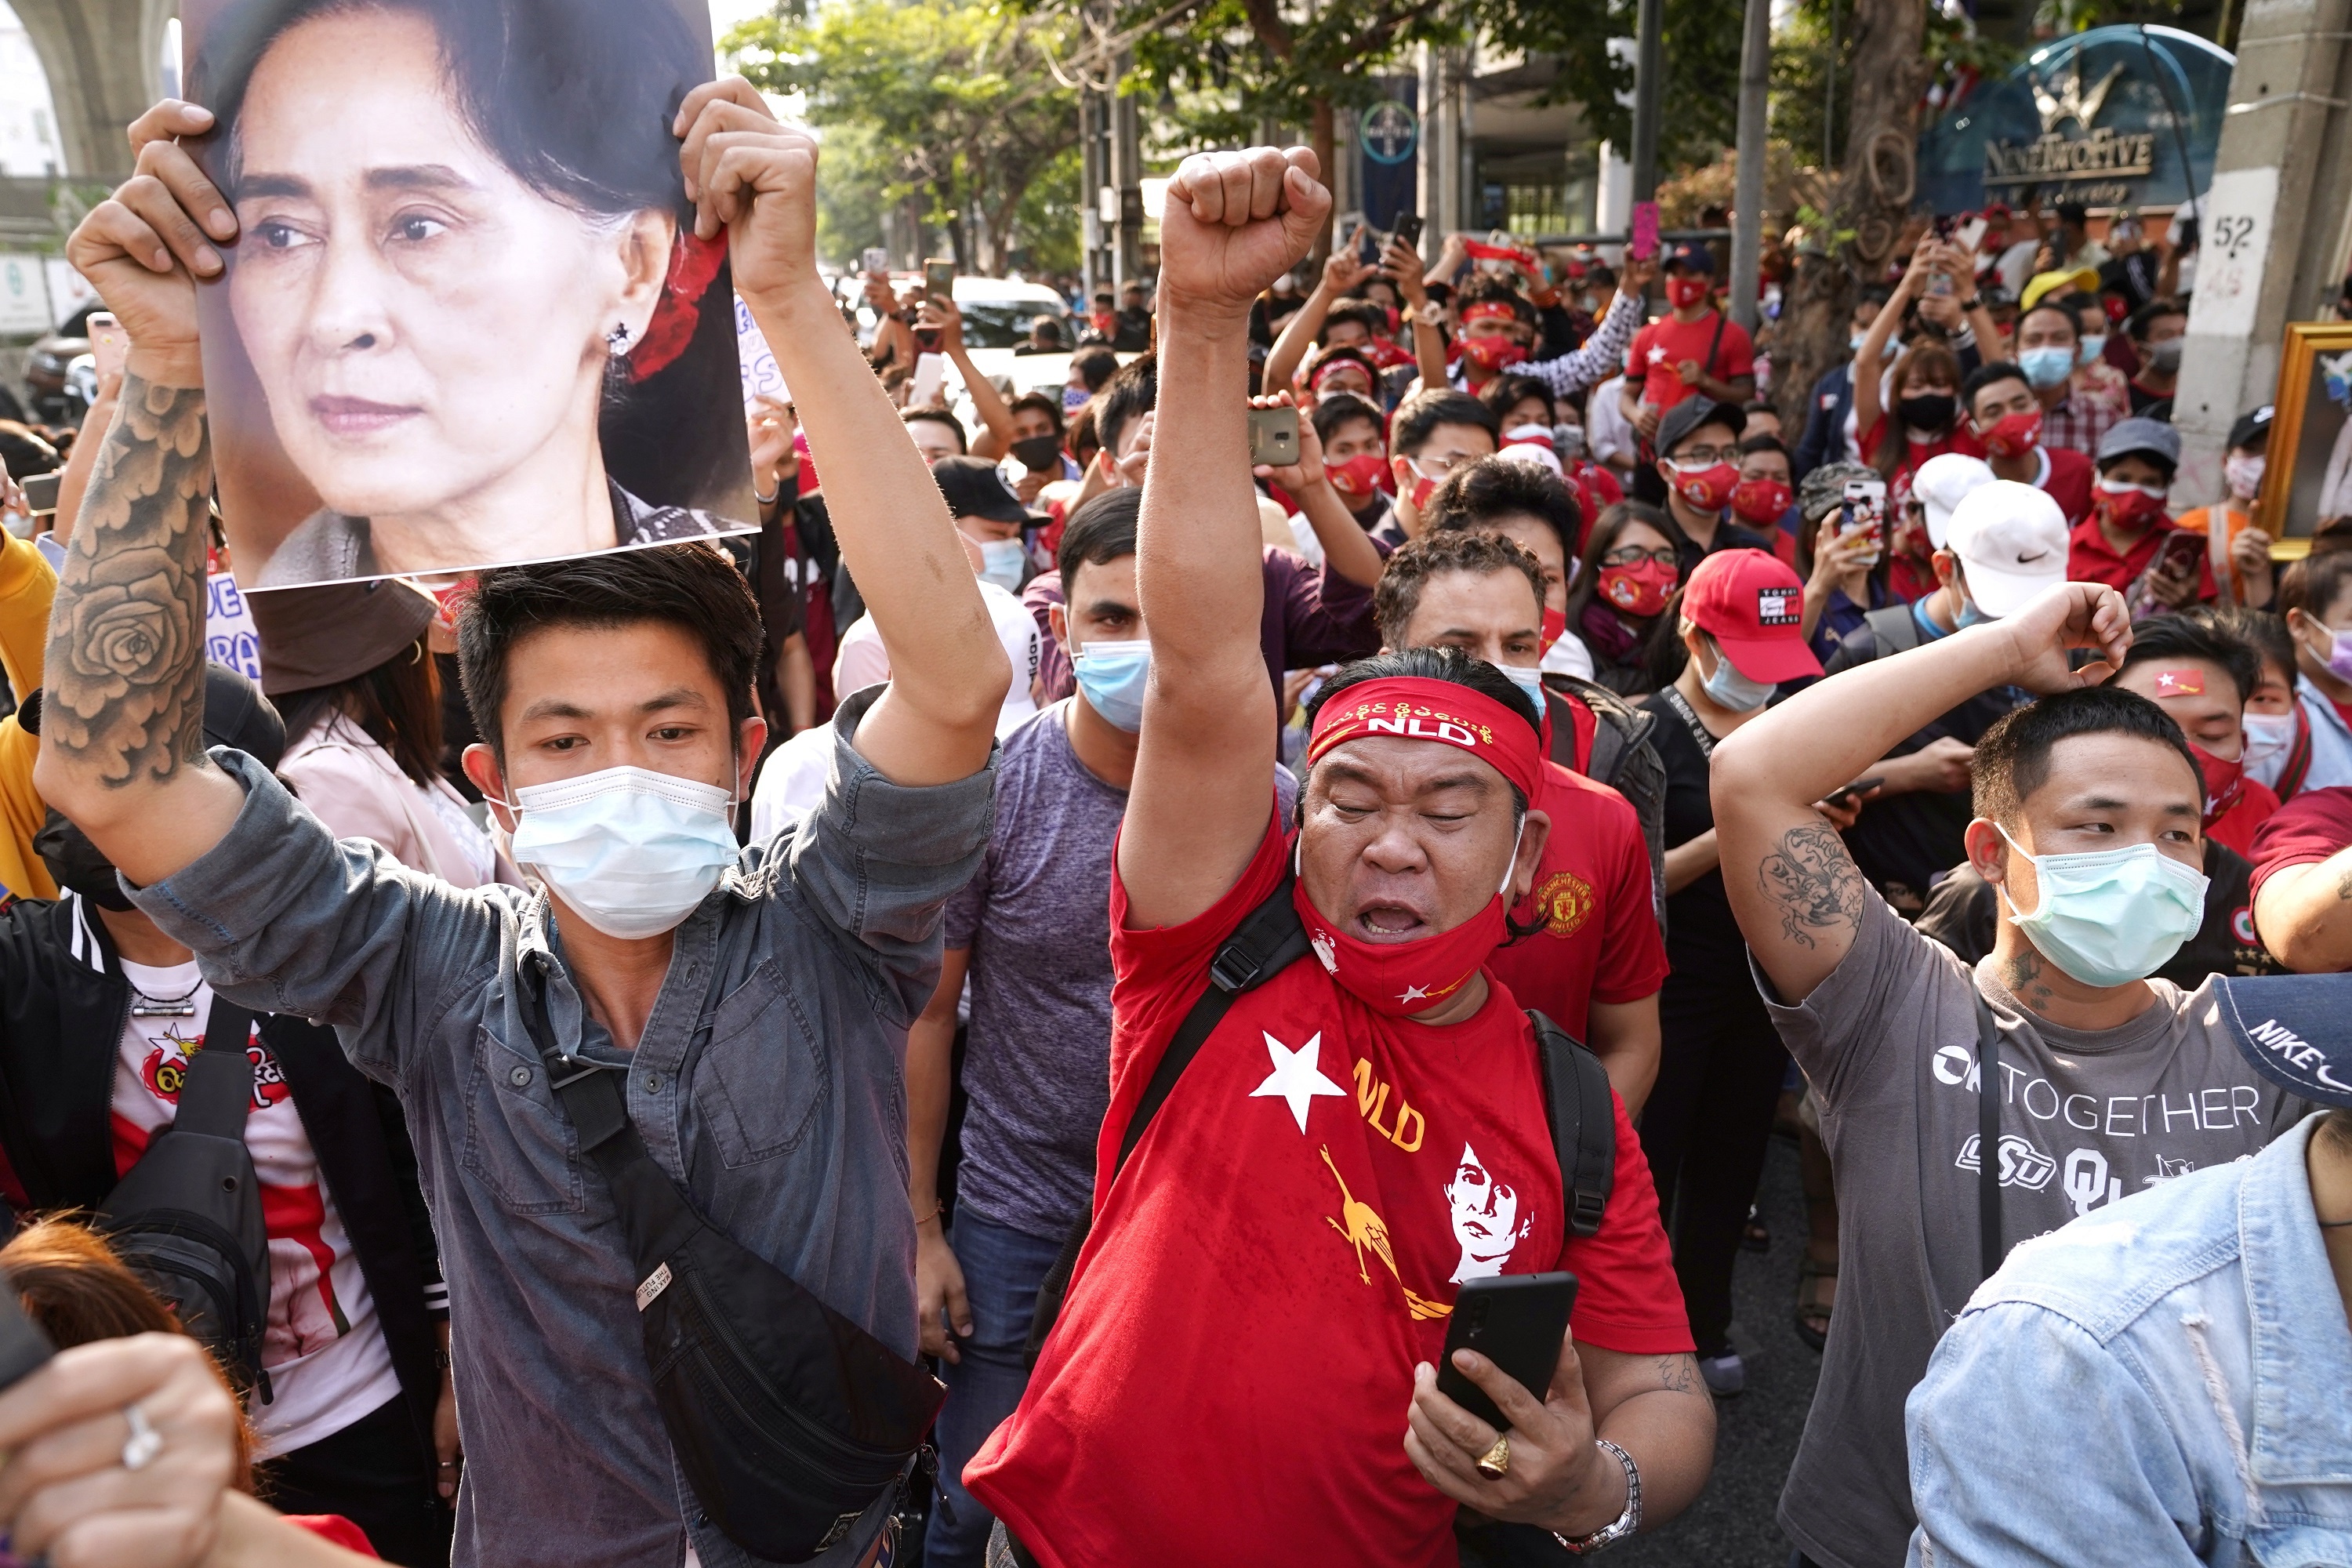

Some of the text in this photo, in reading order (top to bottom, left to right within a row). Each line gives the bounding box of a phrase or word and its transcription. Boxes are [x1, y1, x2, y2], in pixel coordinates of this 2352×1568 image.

[2213, 216, 2254, 247] 52
[1028, 633, 1038, 693] idas
[1367, 717, 1476, 746] NLD
[1541, 877, 1588, 901] MANCHESTER
[1549, 917, 1581, 929] UNITED
[2249, 1019, 2326, 1070] NIKE
[1352, 1057, 1425, 1152] NLD
[1998, 1061, 2260, 1138] TOGETHER
[646, 1273, 670, 1298] MAKING
[655, 1268, 667, 1281] THE
